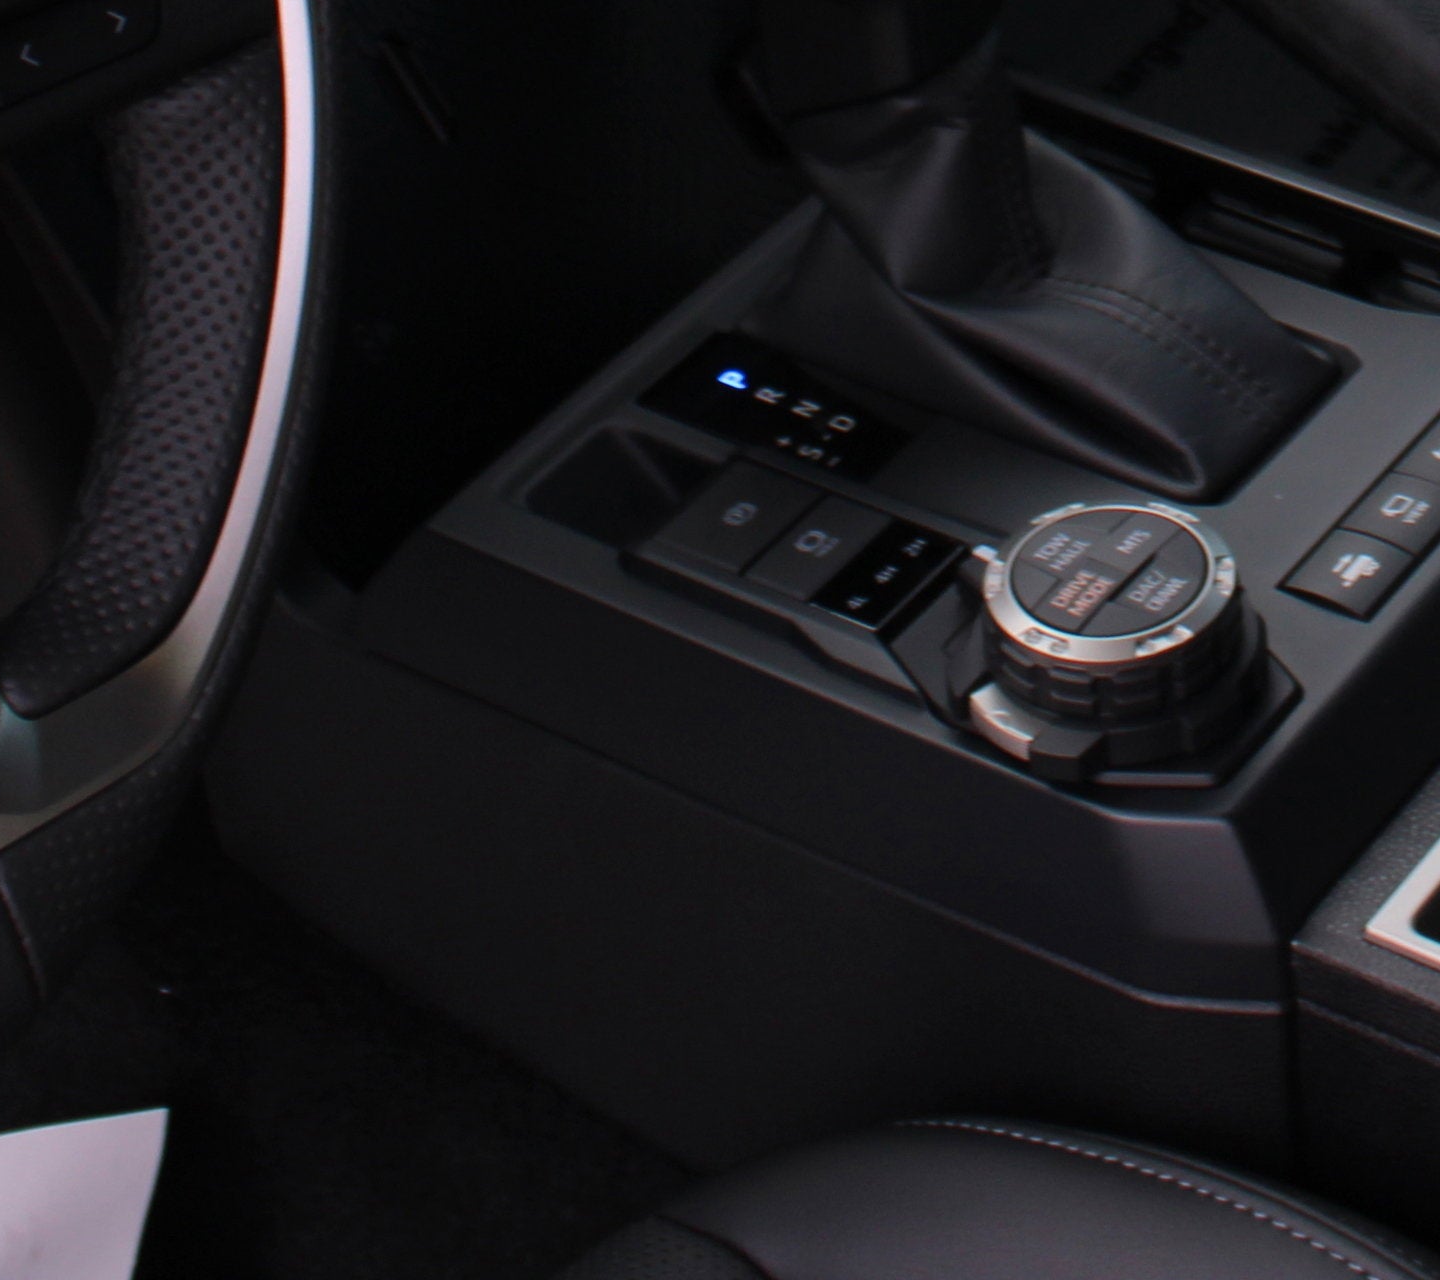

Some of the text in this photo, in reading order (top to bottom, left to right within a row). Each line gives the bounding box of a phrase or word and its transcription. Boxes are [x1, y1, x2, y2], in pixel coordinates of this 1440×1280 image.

[715, 368, 750, 391] P
[752, 386, 788, 407] R
[789, 398, 824, 421] N
[1033, 532, 1072, 563] TOW
[1049, 540, 1093, 574] HAUL
[1115, 529, 1153, 556] MTS
[1050, 569, 1096, 610] DRIVE
[1067, 576, 1116, 618] MODE
